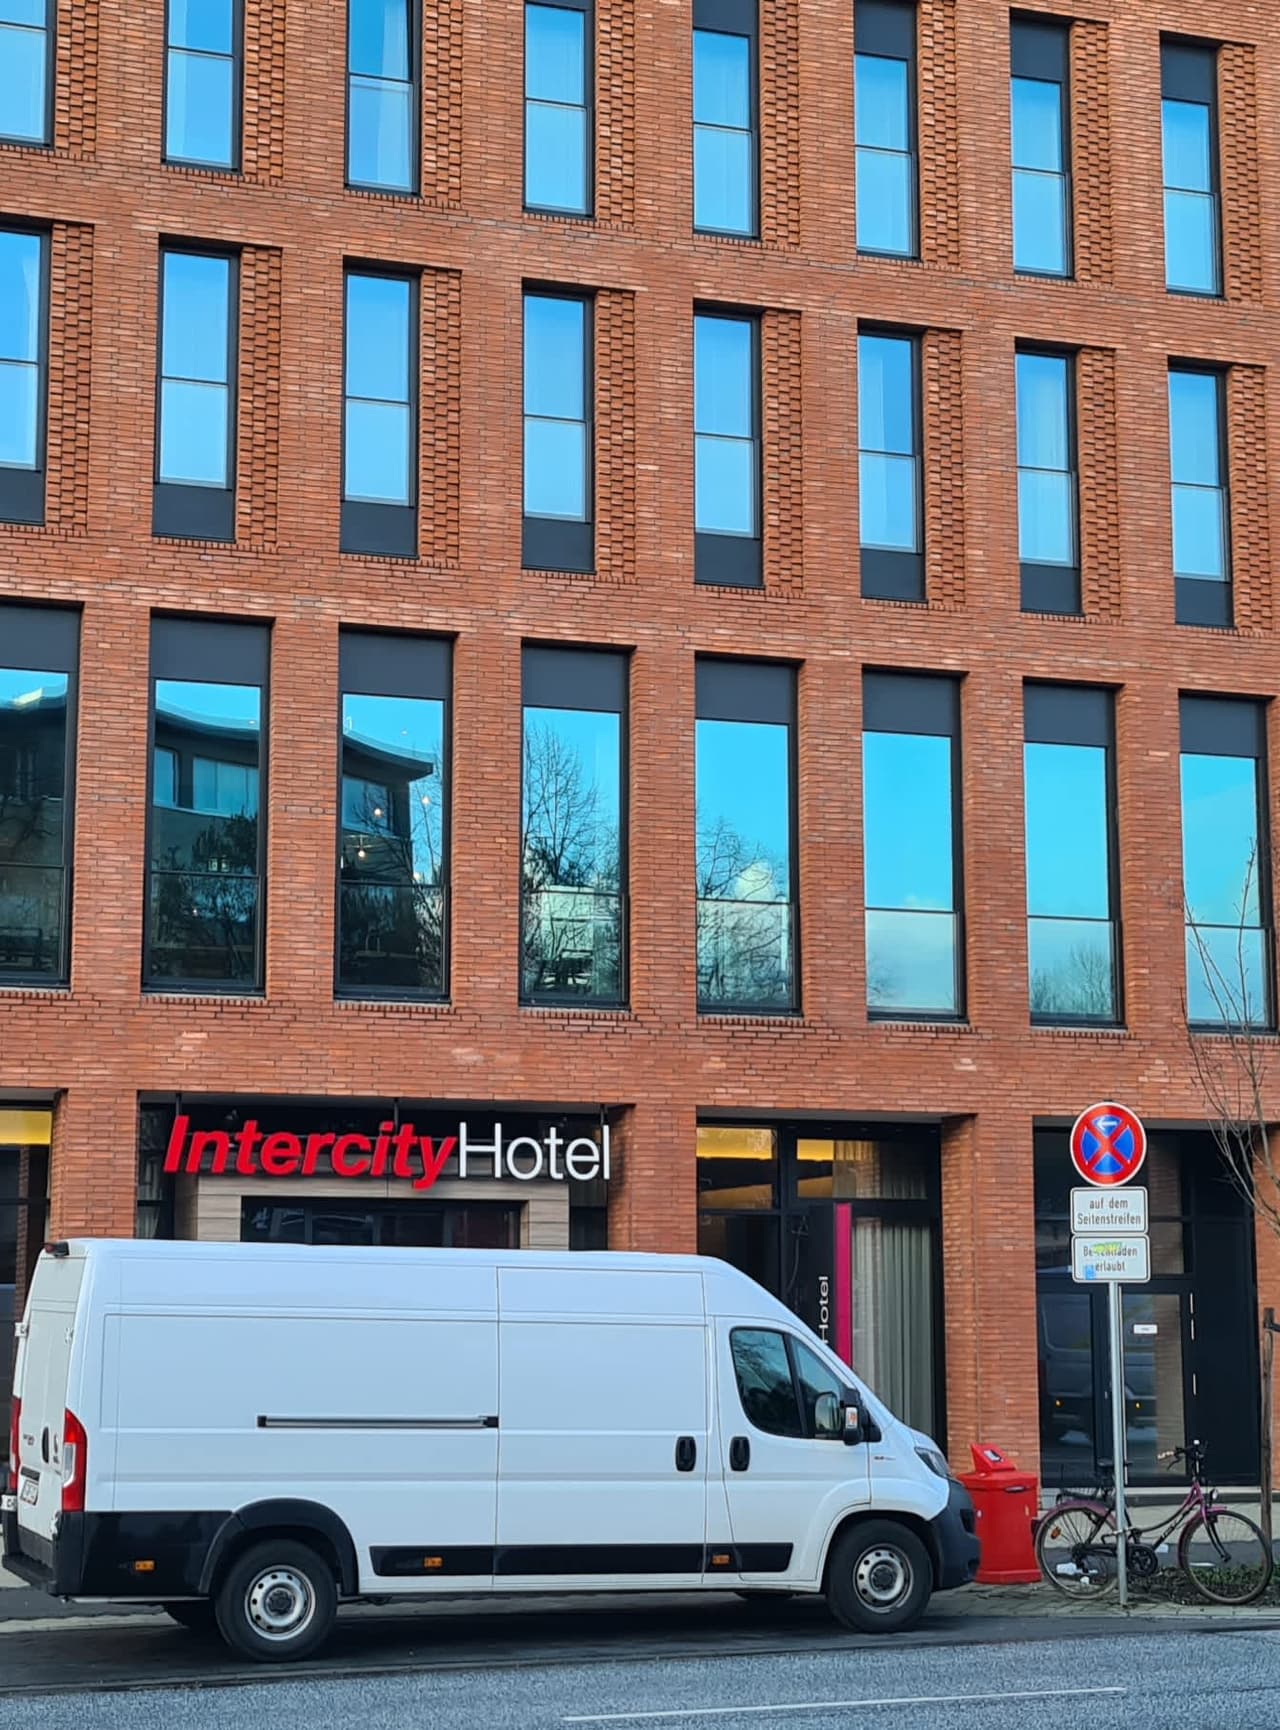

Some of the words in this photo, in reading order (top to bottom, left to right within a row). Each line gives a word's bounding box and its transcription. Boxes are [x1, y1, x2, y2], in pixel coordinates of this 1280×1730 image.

[163, 1114, 610, 1189] IntercityHotel
[1089, 1197, 1104, 1209] auf
[1109, 1197, 1128, 1209] dem
[1077, 1212, 1141, 1225] Seitenstreifen
[1095, 1262, 1125, 1272] erlaubt
